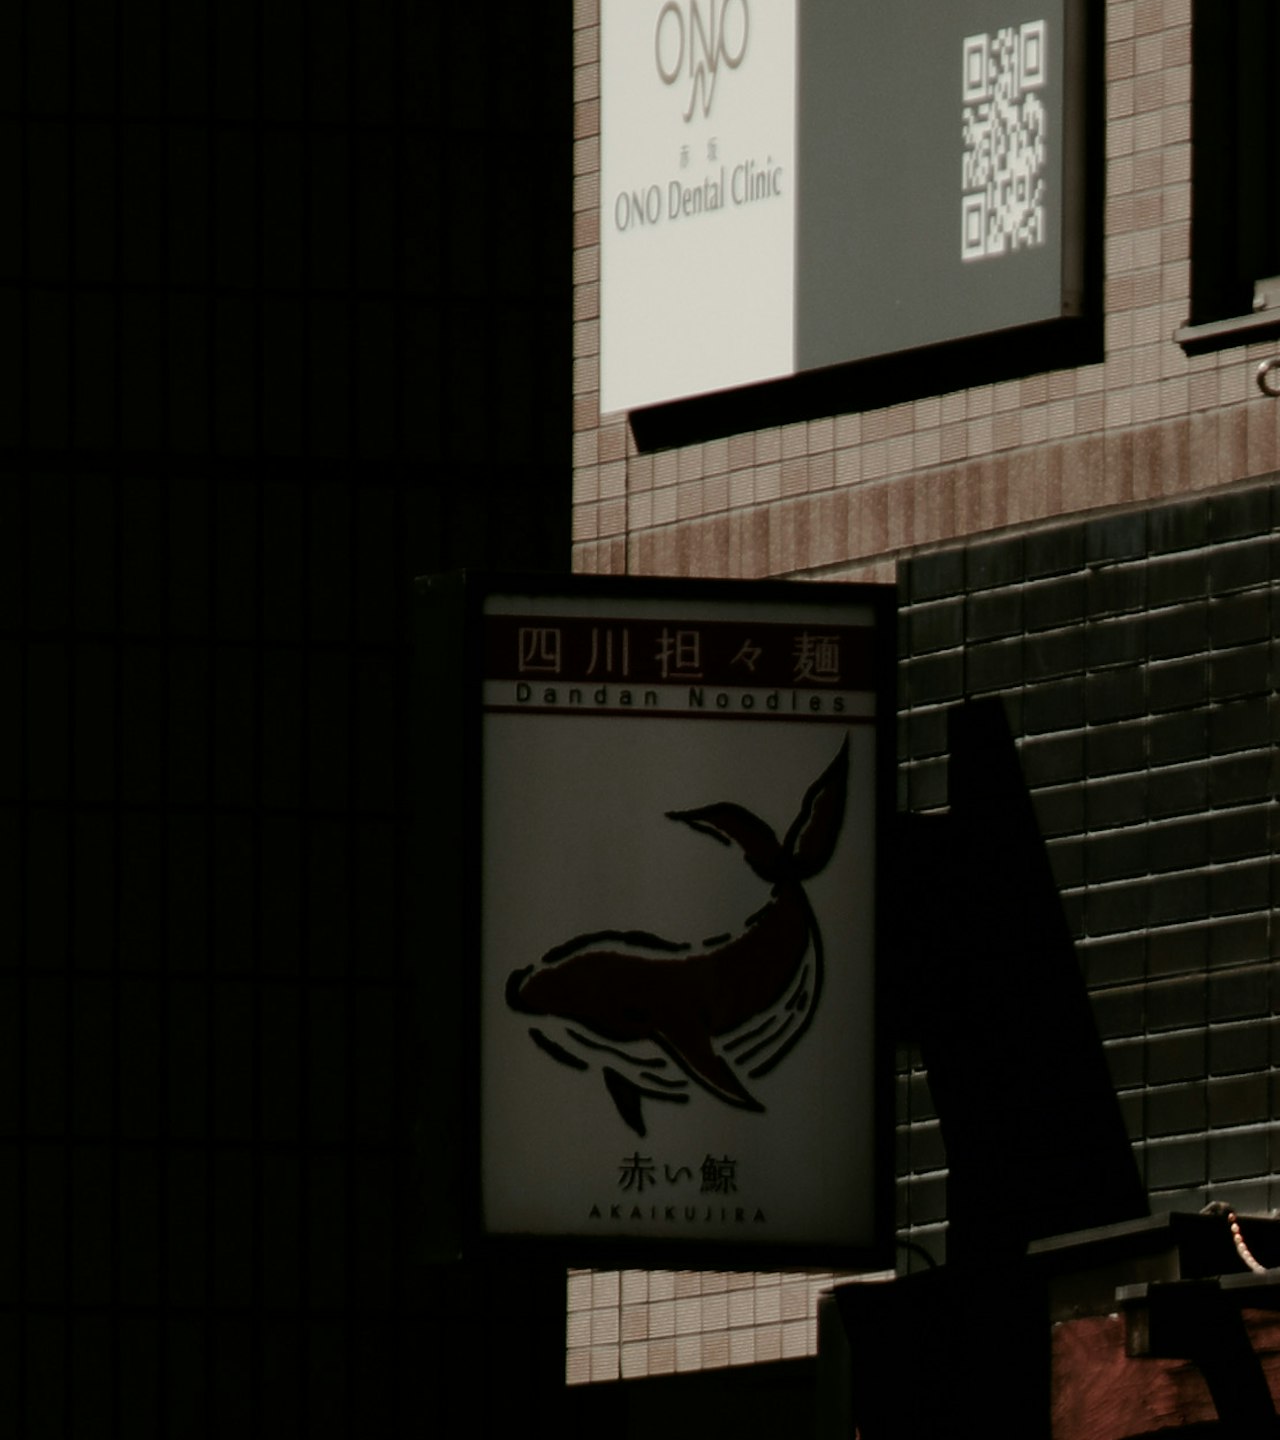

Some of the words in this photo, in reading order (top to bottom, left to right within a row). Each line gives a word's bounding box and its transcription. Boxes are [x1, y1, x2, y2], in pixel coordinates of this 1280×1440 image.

[615, 184, 661, 232] ONO
[668, 167, 724, 220] Dental
[731, 155, 783, 206] Clinic
[517, 627, 842, 683] 四川担々麺
[516, 683, 657, 705] Dandan
[689, 687, 845, 713] Noodles
[617, 1152, 738, 1194] 赤い鯨
[589, 1204, 765, 1223] AKAIKUJIRA
